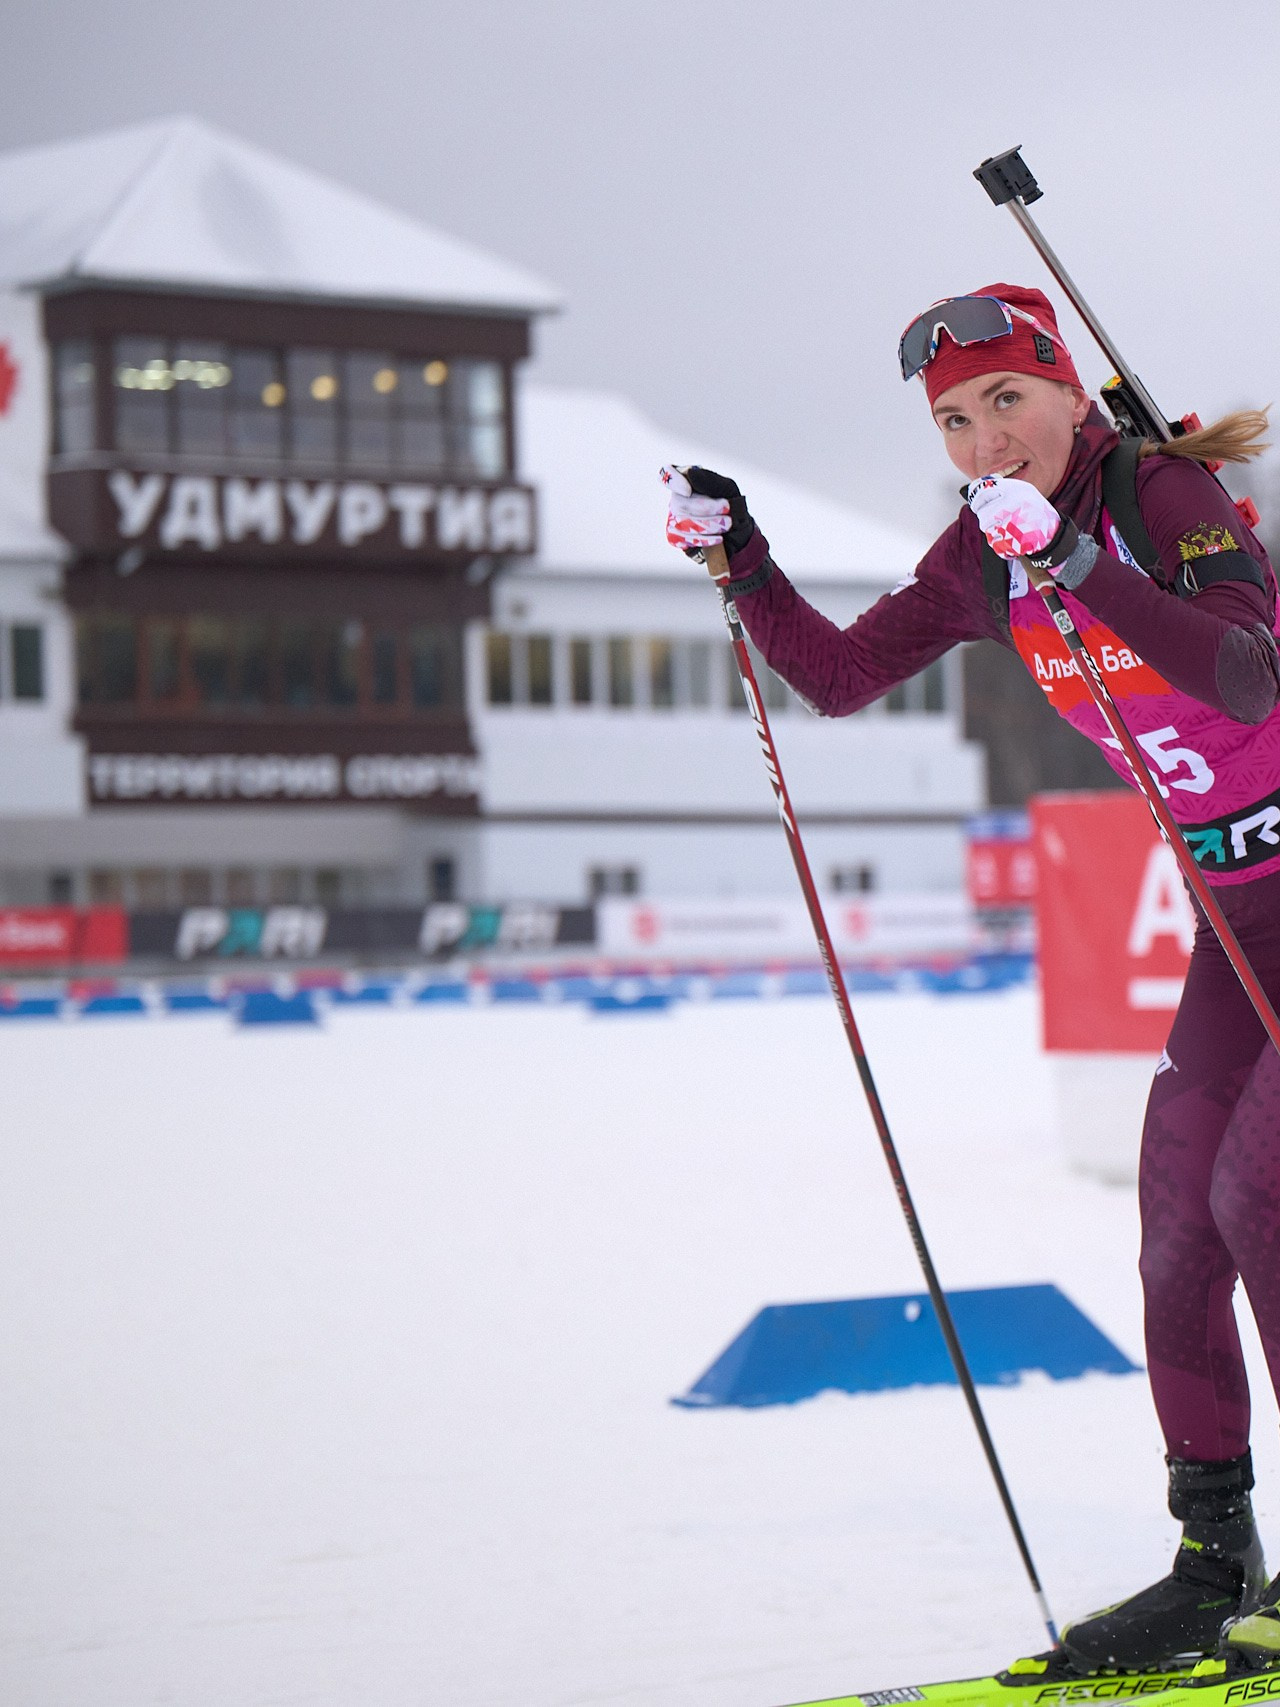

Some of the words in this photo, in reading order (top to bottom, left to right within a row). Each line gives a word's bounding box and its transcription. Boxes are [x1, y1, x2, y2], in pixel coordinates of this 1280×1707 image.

[110, 473, 533, 550] УДМУРТИЯ
[91, 754, 341, 797] ТЕРРИТОРИЯ
[1100, 725, 1215, 799] 5
